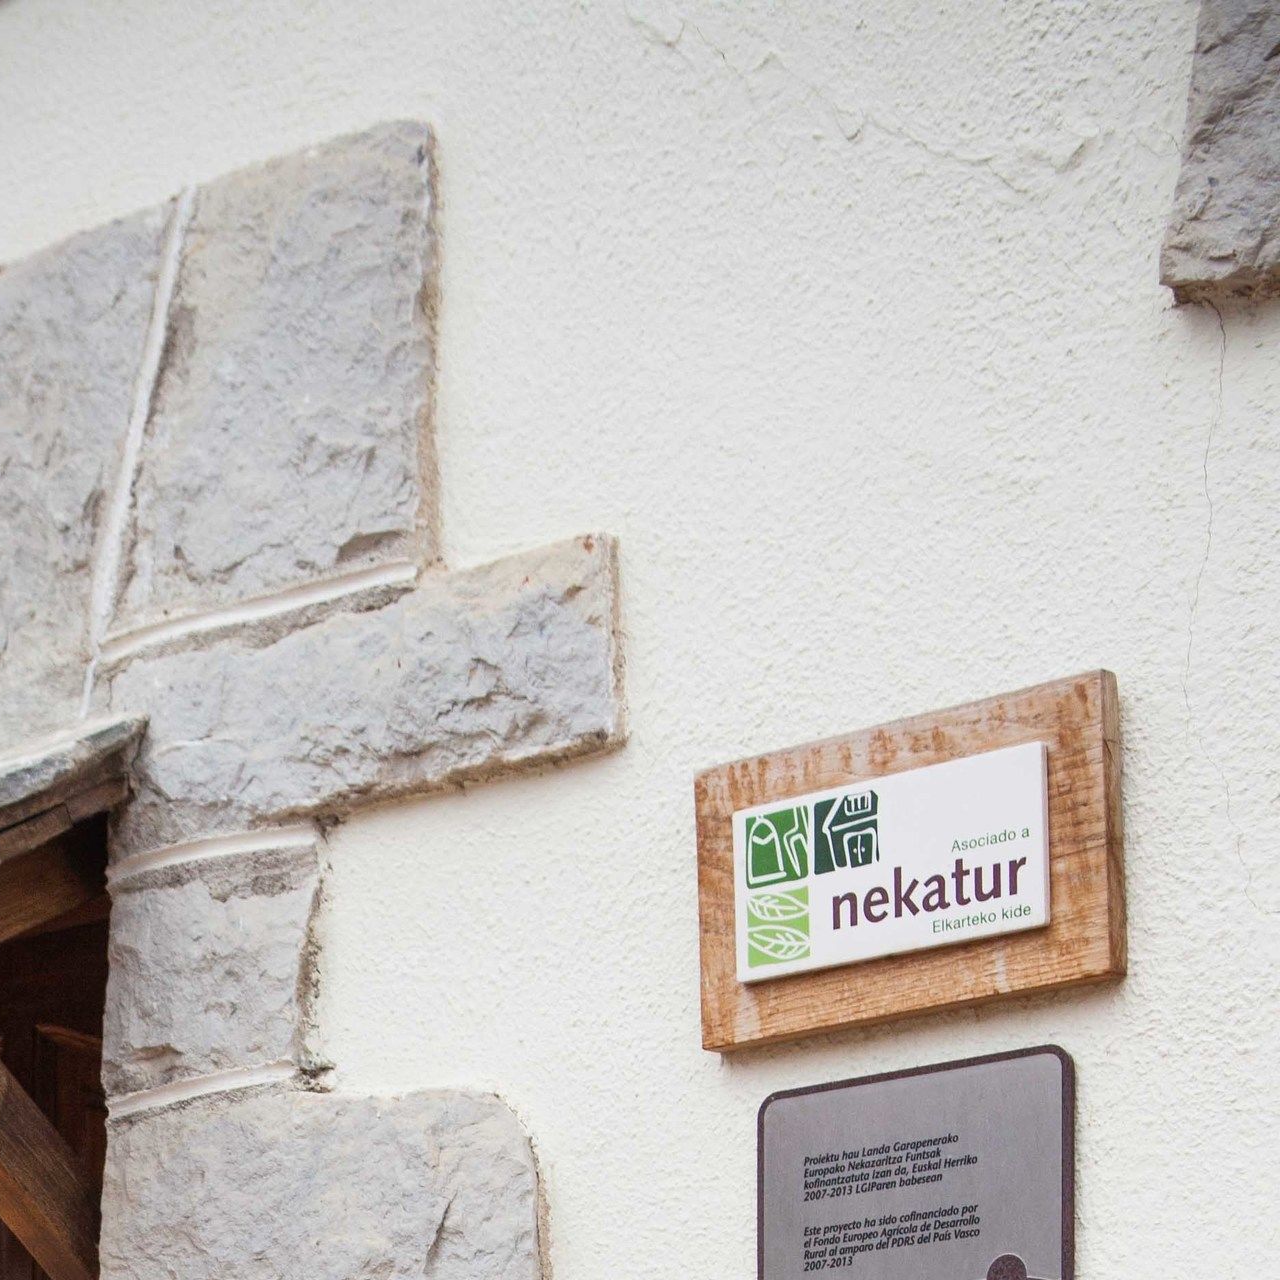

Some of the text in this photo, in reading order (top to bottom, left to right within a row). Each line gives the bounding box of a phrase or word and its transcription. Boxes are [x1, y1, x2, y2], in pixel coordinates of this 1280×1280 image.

[951, 828, 1031, 853] Asociado a
[831, 855, 1028, 931] nekatur
[931, 903, 1032, 934] Elkarteko kide
[803, 1133, 959, 1166] Proiektu hau Landa Garapenerako
[803, 1147, 942, 1178] Europako Nekazaritza Funtsak
[803, 1154, 978, 1190] kofinantzatuta izan da, Euskal Herriko
[803, 1185, 853, 1202] 2007-2013
[899, 1173, 943, 1187] babesean
[803, 1204, 979, 1236] Este proyecto ha sido cofinanciado por
[803, 1239, 811, 1248] el
[813, 1235, 840, 1247] Fondo
[842, 1231, 878, 1243] Europeo
[920, 1221, 932, 1232] de
[933, 1215, 980, 1230] Desarrollo
[803, 1229, 980, 1260] Rural al amparo del PDRS del País Vasco
[803, 1256, 853, 1272] 2007-2013
